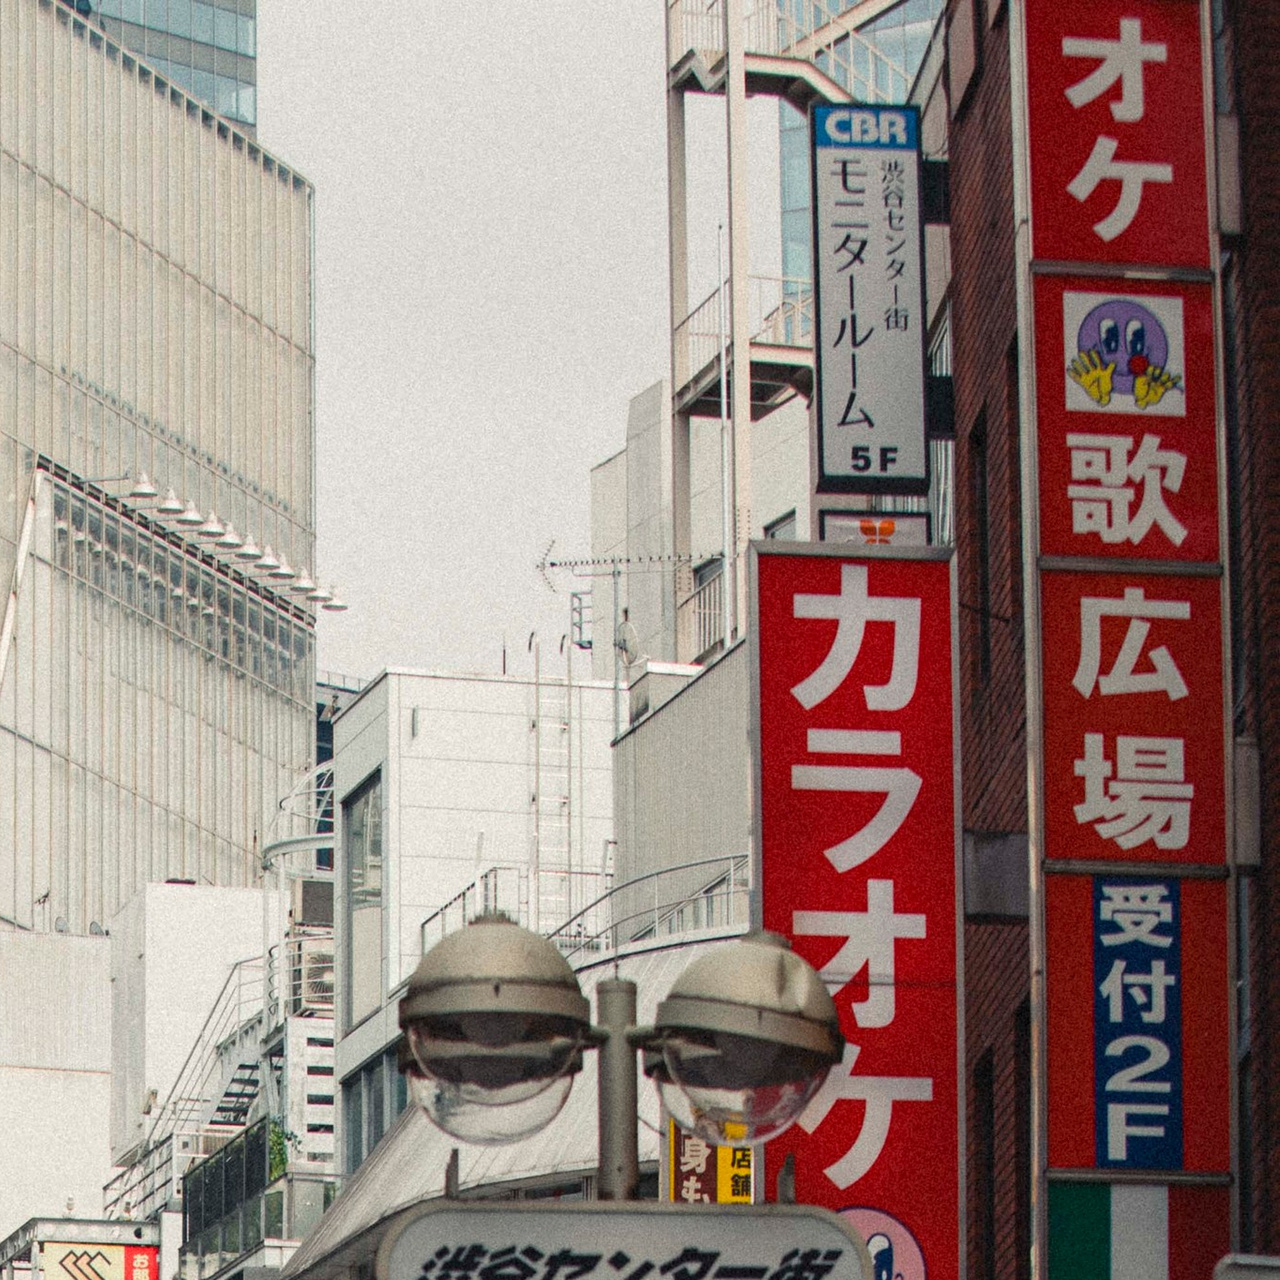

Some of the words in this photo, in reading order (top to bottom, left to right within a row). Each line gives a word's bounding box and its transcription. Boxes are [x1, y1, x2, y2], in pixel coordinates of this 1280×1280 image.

[825, 110, 907, 144] CBR
[880, 159, 909, 333] 渋谷センター街
[1061, 18, 1173, 243] オケ
[829, 158, 875, 429] モニタールーム
[850, 446, 898, 472] 5F
[1065, 433, 1194, 851] 歌広場
[789, 564, 934, 1190] カラオケ
[1098, 884, 1176, 1162] 受付2F
